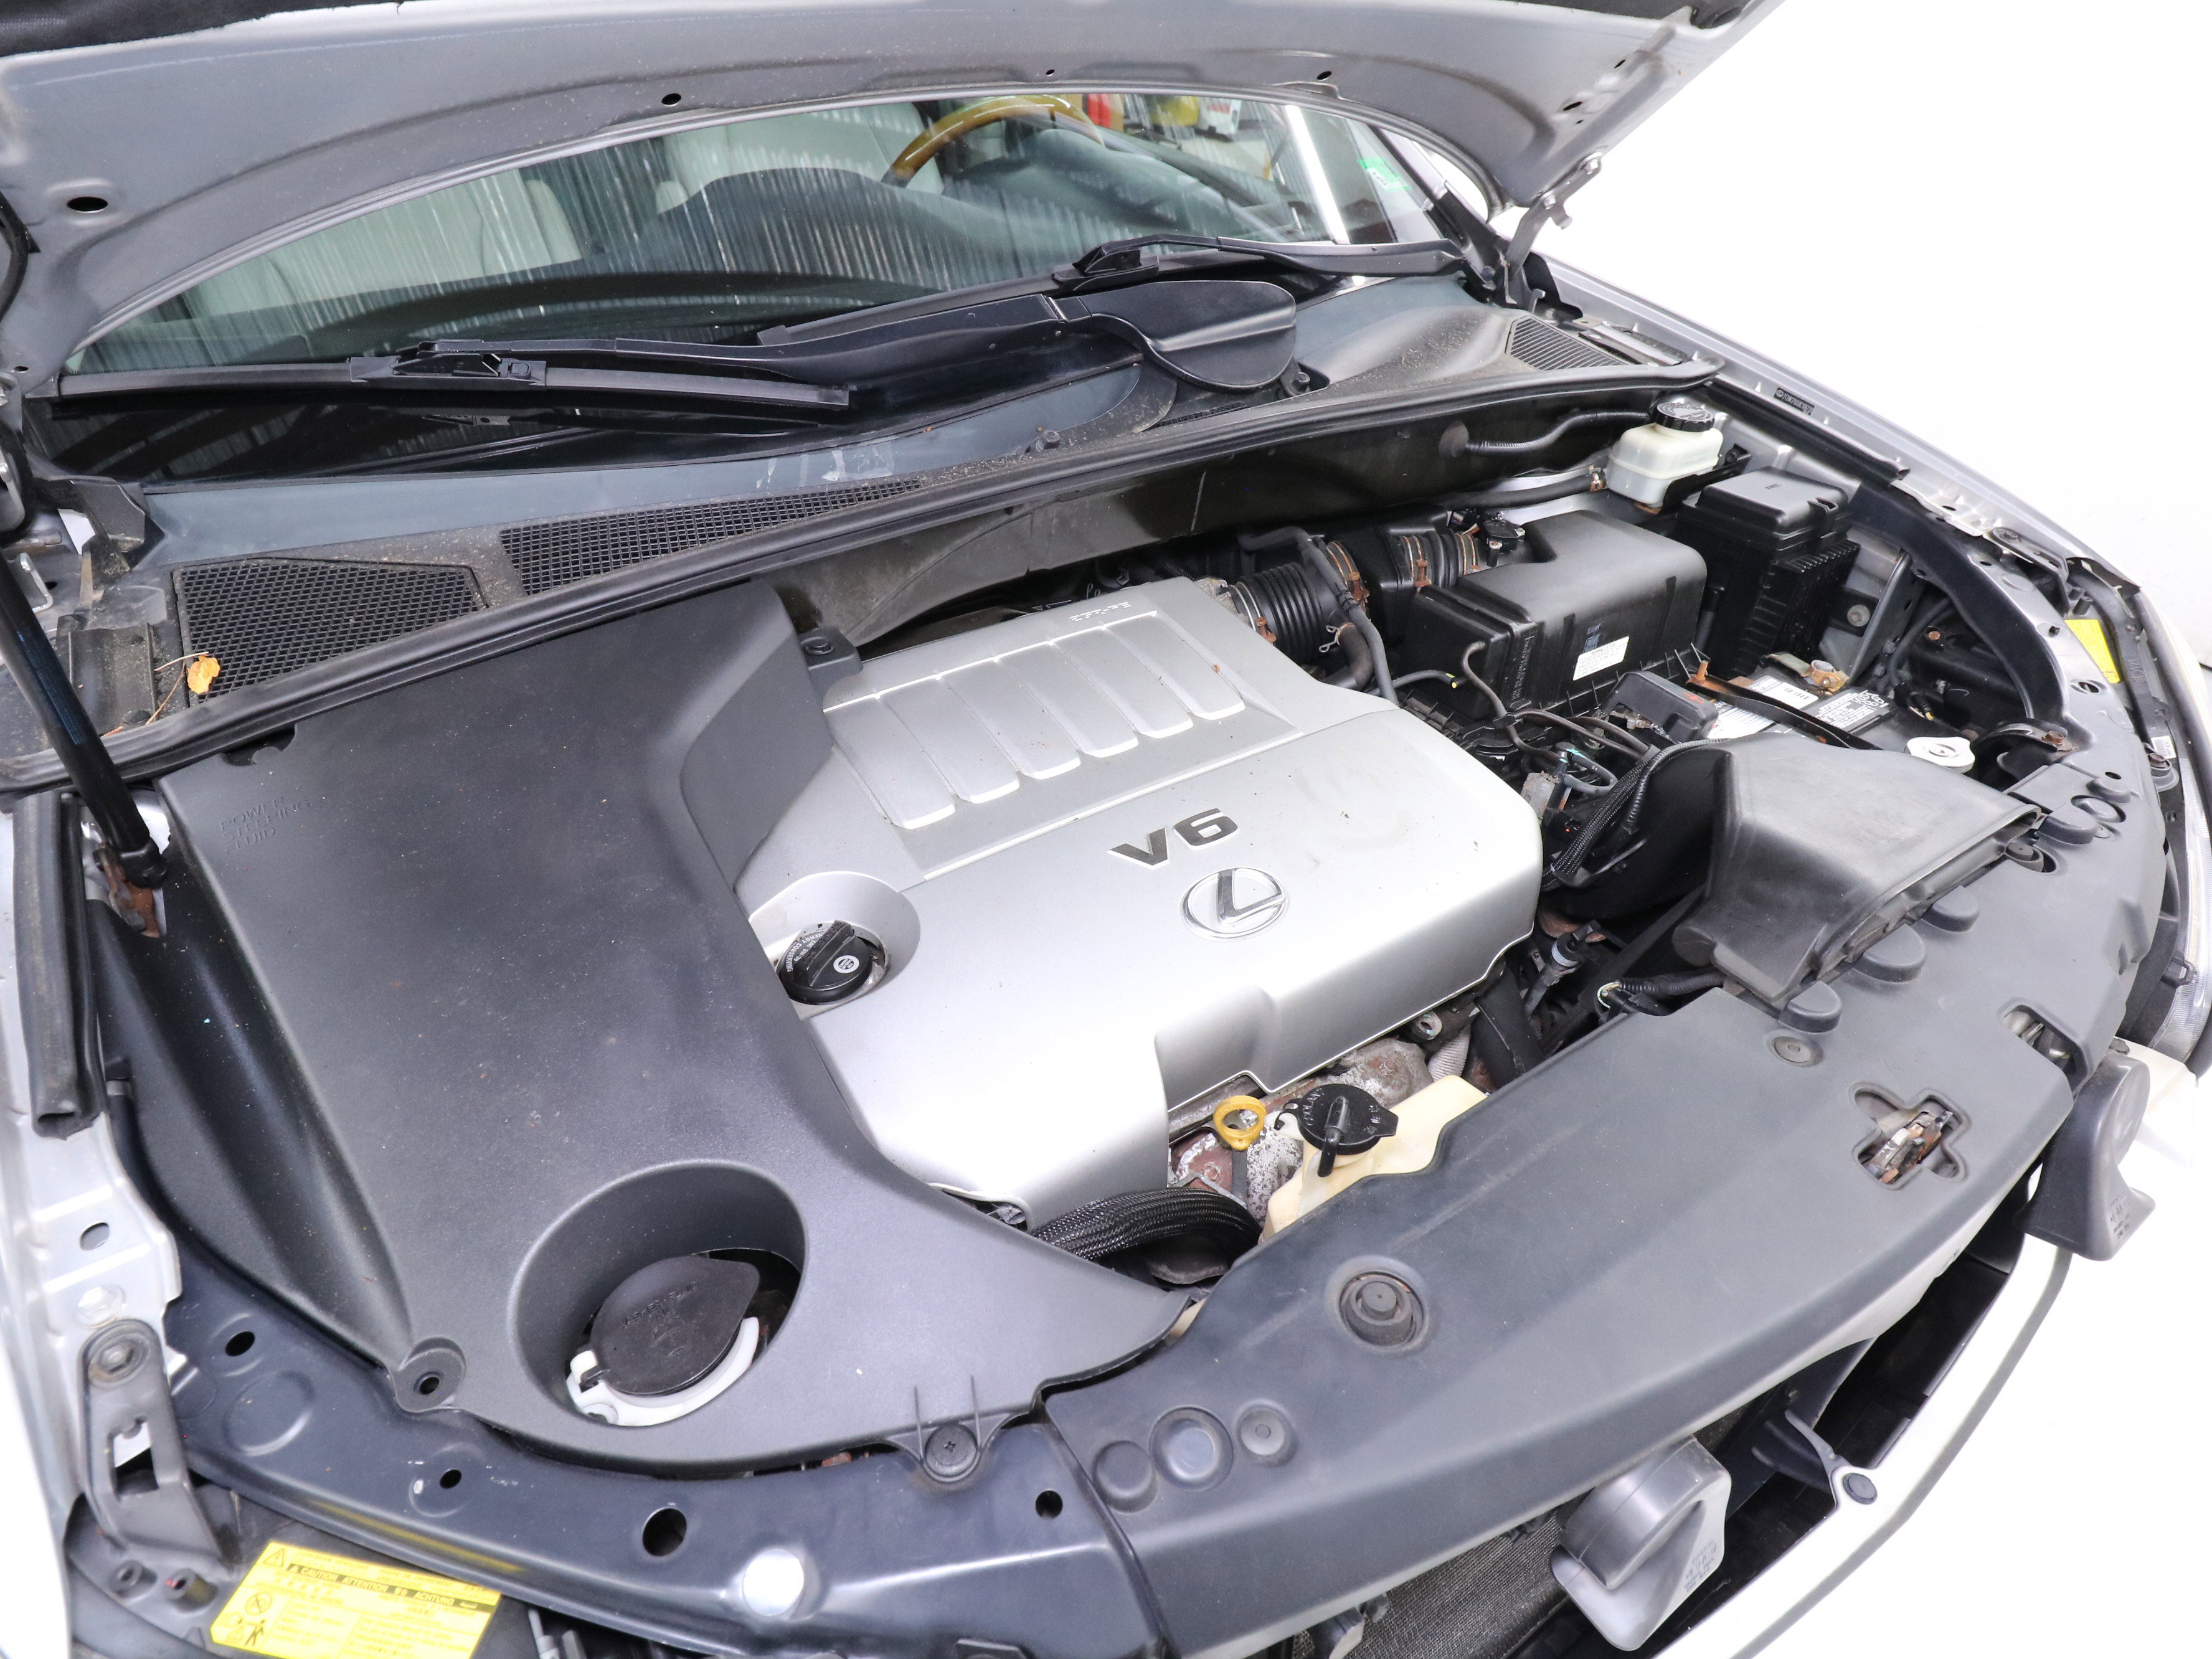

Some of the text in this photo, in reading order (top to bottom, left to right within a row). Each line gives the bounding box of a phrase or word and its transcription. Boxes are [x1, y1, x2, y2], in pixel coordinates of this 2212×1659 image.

[1107, 808, 1240, 870] V6
[785, 932, 825, 973] NERGY CONSERVING
[299, 1567, 339, 1582] CAUTION
[341, 1576, 390, 1594] ATTENTION
[412, 1590, 456, 1607] ACHTUNG
